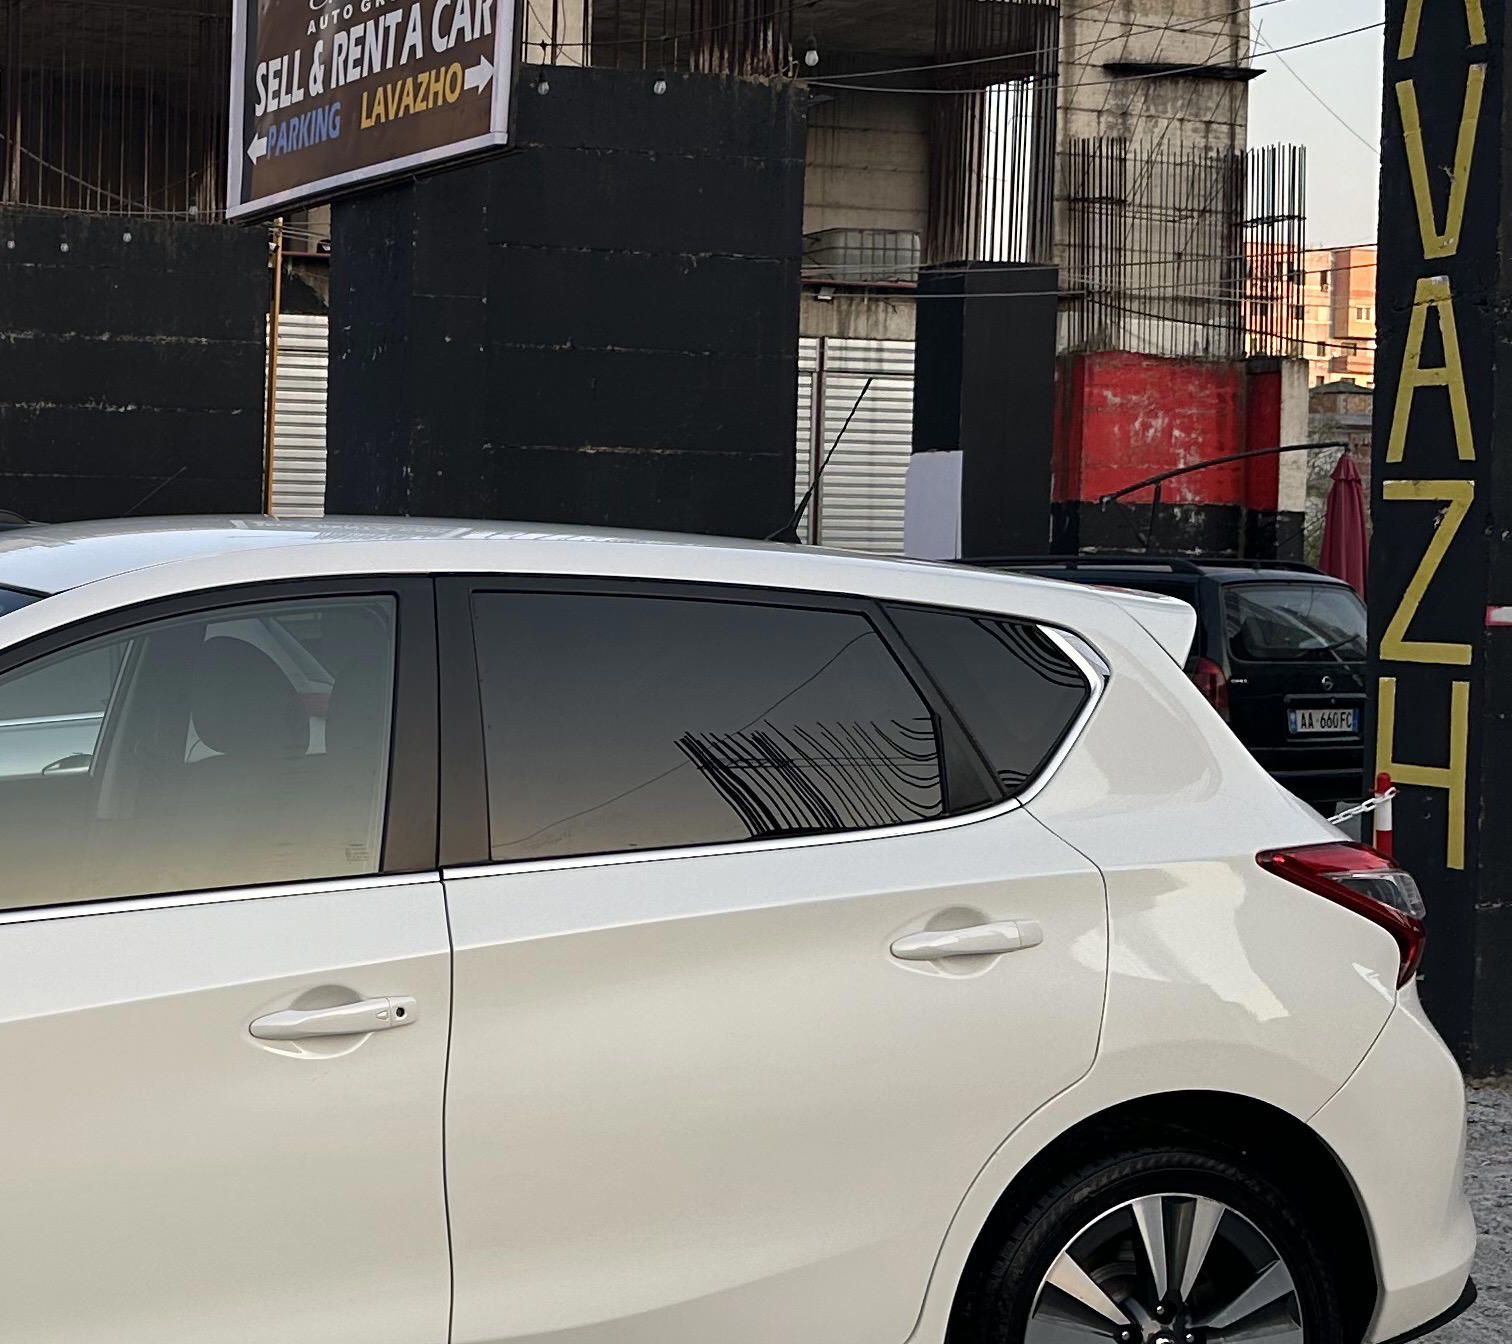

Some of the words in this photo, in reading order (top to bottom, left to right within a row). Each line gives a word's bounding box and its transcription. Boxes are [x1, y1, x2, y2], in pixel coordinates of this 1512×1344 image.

[307, 4, 353, 35] AUTO
[254, 49, 304, 117] SELL
[309, 38, 325, 97] &
[266, 102, 341, 160] PARKING
[360, 62, 464, 130] LAVAZHO
[1301, 712, 1314, 729] AA
